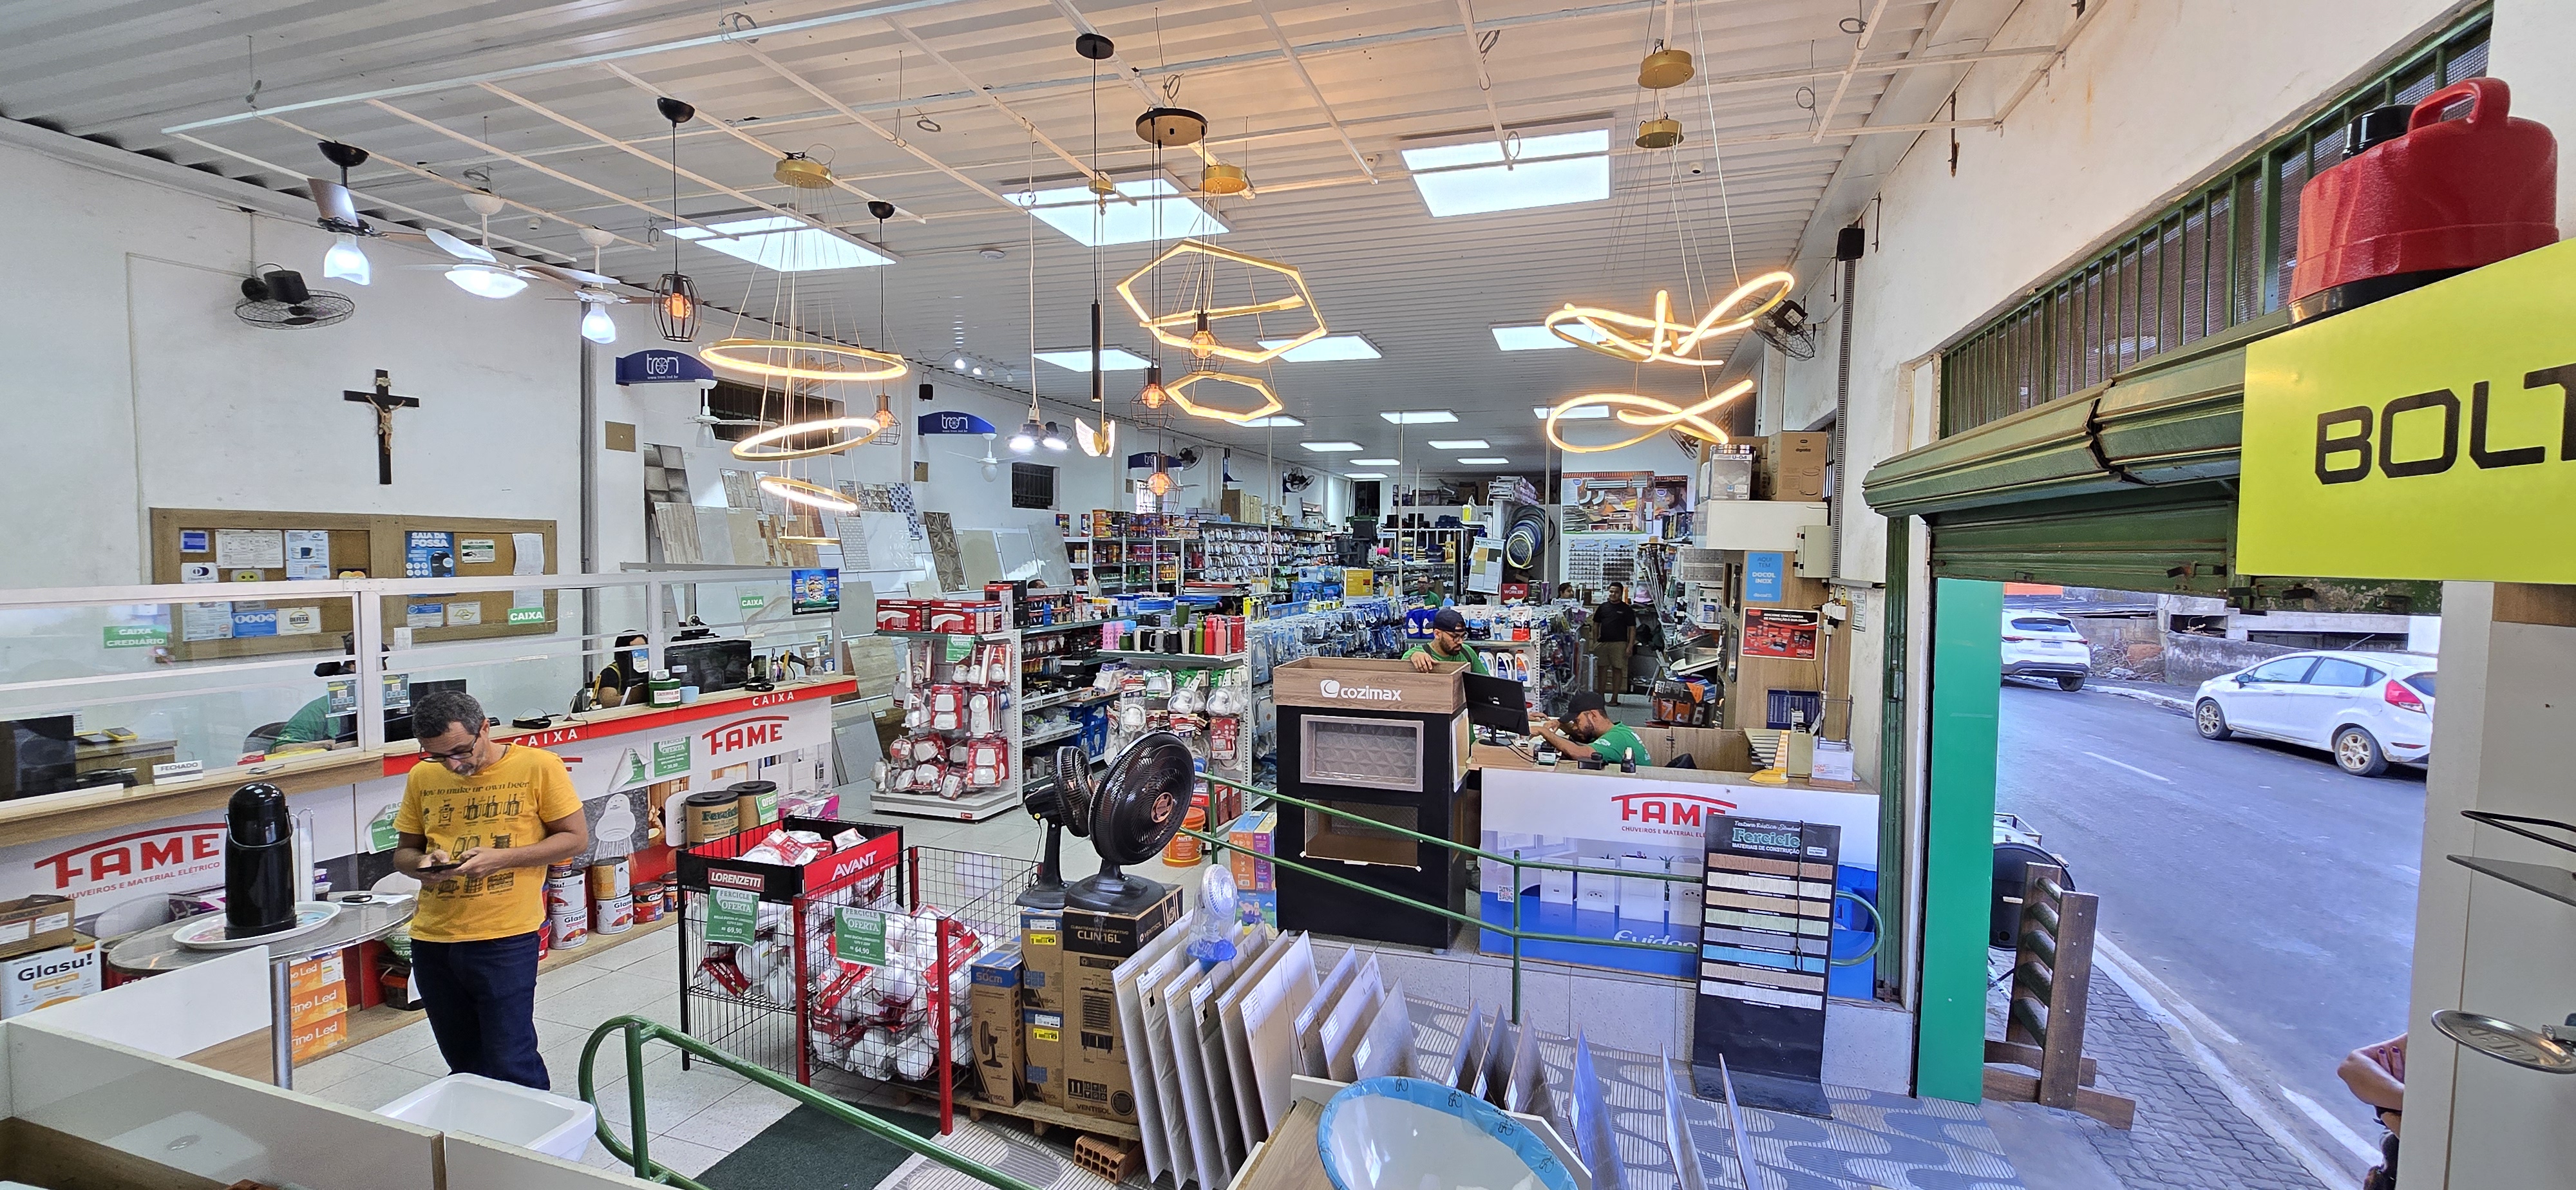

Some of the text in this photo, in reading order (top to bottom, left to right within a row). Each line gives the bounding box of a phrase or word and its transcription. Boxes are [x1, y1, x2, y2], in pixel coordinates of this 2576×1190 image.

[647, 354, 679, 374] tron
[942, 413, 968, 430] tron
[2315, 363, 2576, 485] BOLT
[411, 539, 450, 547] FOSSA
[509, 611, 544, 621] CAIXA
[106, 637, 164, 646] CREDIÁRIO
[752, 692, 794, 706] CAIXA
[1340, 685, 1402, 701] cozimax
[513, 728, 578, 747] CAIXA
[701, 715, 790, 756] FAME
[160, 762, 198, 771] FECHADO
[485, 782, 506, 791] own
[1621, 826, 1656, 834] CHUVEIROS
[1732, 827, 1801, 848] Fercicle
[34, 822, 227, 889] FAME
[1766, 845, 1800, 855] CONSTRUÇÃO
[831, 851, 877, 882] AVANT
[64, 884, 117, 900] HUVEIROS
[127, 872, 175, 887] MATERIAL
[178, 862, 220, 876] ELÉTRICO
[711, 872, 761, 888] LORENZETTI
[720, 890, 750, 900] FERCICLE
[721, 901, 752, 913] OFERTA
[846, 908, 877, 918] FERCICLE
[848, 919, 880, 932] OFERTA
[17, 952, 93, 981] Glasu!
[300, 963, 317, 976] Led
[314, 989, 337, 1006] Led
[316, 1021, 337, 1039] Led
[1076, 1103, 1112, 1115] VENTISOL
